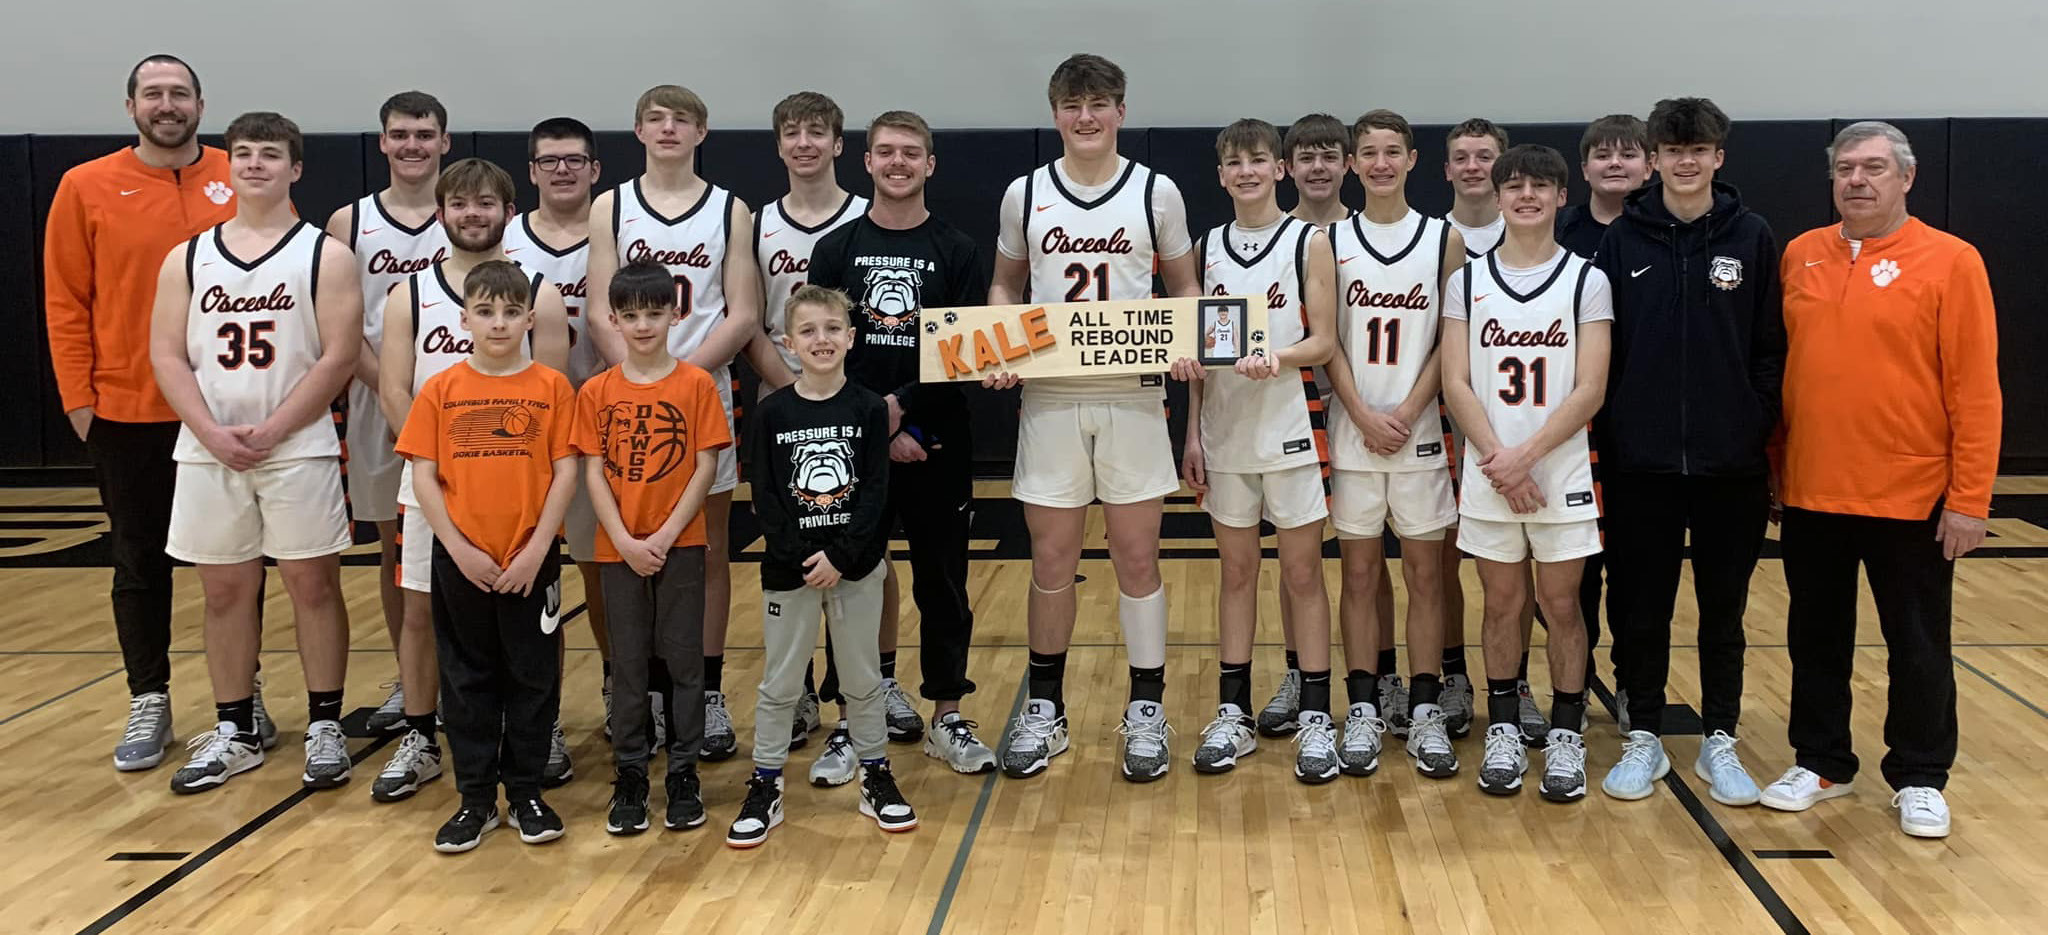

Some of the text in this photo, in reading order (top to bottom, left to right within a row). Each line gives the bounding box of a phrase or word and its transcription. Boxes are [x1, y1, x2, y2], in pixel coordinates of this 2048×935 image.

[626, 238, 712, 270] Osceola
[1041, 226, 1133, 255] Osceola
[368, 246, 450, 275] Osceol
[854, 256, 936, 272] PRESSURE IS A
[1063, 262, 1110, 302] 21
[1345, 278, 1430, 311] Osceola
[200, 282, 295, 314] Osceola
[1069, 309, 1174, 328] ALL TIME
[1480, 318, 1569, 349] Osceola
[216, 319, 276, 371] 35
[865, 333, 916, 348] PRIVILEGE
[937, 306, 1057, 379] KALE
[1071, 328, 1174, 346] REBOUND
[1366, 316, 1401, 366] 11
[1080, 347, 1169, 367] LEADER
[1498, 356, 1547, 407] 31
[627, 404, 653, 482] DAWGS
[776, 426, 862, 445] PRESSURE IS A
[798, 512, 852, 530] PRIVILEGE
